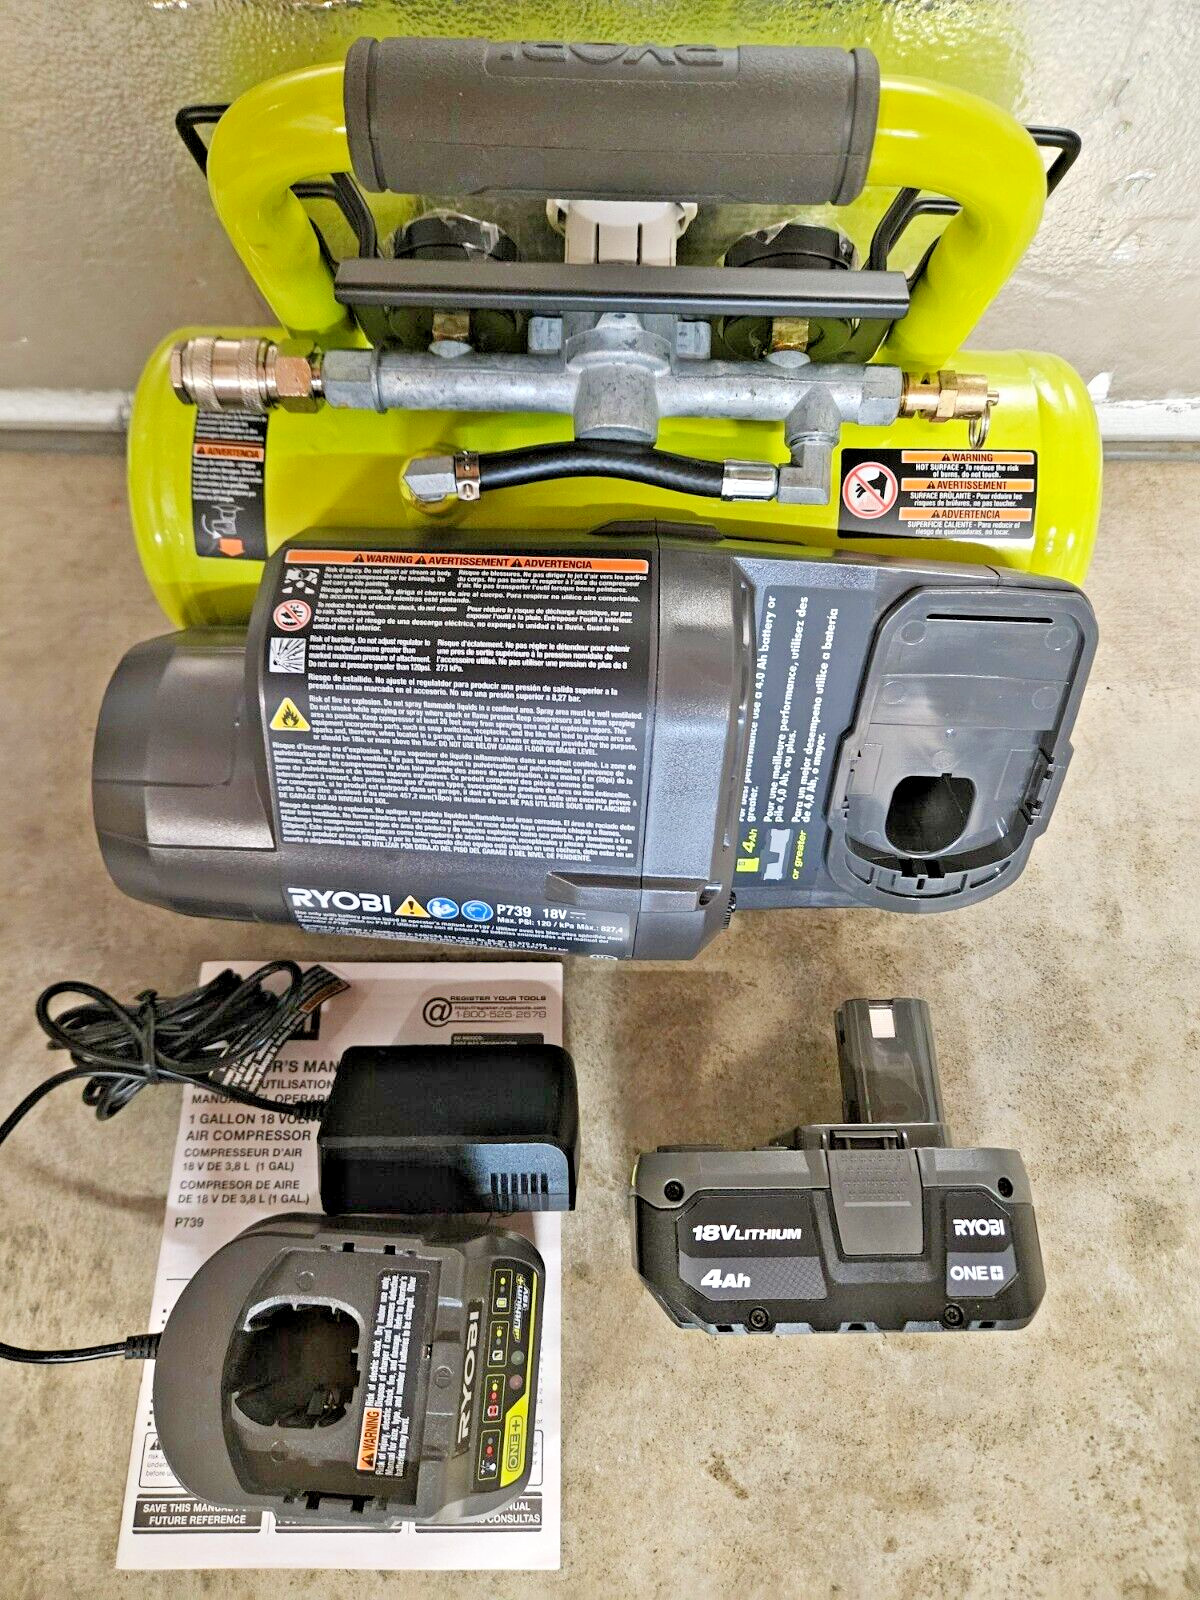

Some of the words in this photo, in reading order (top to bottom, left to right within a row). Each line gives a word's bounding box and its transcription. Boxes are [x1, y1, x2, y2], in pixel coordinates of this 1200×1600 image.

[952, 454, 993, 462] WARNING
[937, 481, 1007, 489] AVERTISSEMENT
[942, 510, 1000, 518] ADVERTENCIA
[365, 554, 414, 564] WARNING
[428, 556, 510, 568] AVERTISSEMENT
[524, 558, 593, 569] ADVERTENCIA
[768, 595, 776, 608] or
[796, 596, 808, 618] des
[758, 611, 776, 652] battery
[821, 608, 838, 650] batería
[790, 620, 805, 660] utilisez
[757, 654, 768, 670] Ah
[822, 652, 830, 660] a
[436, 664, 448, 672] 273
[815, 662, 829, 694] utilice
[755, 691, 762, 699] a
[780, 661, 799, 732] performance,
[753, 701, 761, 719] use
[785, 729, 797, 753] plus.
[813, 732, 826, 765] mayor.
[772, 733, 786, 779] meilleure
[784, 756, 792, 768] ou
[779, 770, 792, 787] Ah,
[800, 756, 812, 785] mejor
[769, 781, 778, 799] une
[798, 786, 806, 799] un
[806, 776, 819, 793] Ah,
[747, 785, 759, 822] greater.
[776, 788, 787, 804] 4,0
[804, 794, 815, 809] 4,0
[763, 801, 774, 822] Pour
[775, 804, 784, 822] pile
[791, 801, 803, 822] Para
[802, 810, 811, 823] de
[742, 828, 758, 854] 4Ah
[794, 829, 807, 867] greater
[792, 868, 800, 880] or
[288, 888, 392, 913] RYOBI
[496, 904, 532, 917] P739
[543, 909, 567, 920] 18V
[497, 916, 516, 924] Max.
[519, 918, 535, 926] PSI:
[601, 926, 624, 934] 827,4
[190, 1115, 194, 1124] 1
[200, 1114, 255, 1124] GALLON
[261, 1114, 274, 1124] 18
[186, 1130, 208, 1140] AIR
[213, 1130, 311, 1141] COMPRESSOR
[184, 1148, 269, 1157] COMPRESSEUR
[273, 1148, 302, 1157] D'AIR
[183, 1162, 193, 1171] 18
[197, 1162, 204, 1171] V
[207, 1162, 222, 1171] DE
[225, 1162, 241, 1171] 3,8
[244, 1162, 250, 1171] L
[256, 1162, 265, 1172] (1
[268, 1162, 294, 1172] GAL)
[180, 1180, 252, 1189] COMPRESOR
[256, 1180, 271, 1189] DE
[273, 1180, 300, 1189] AIRE
[178, 1195, 193, 1203] DE
[197, 1195, 208, 1203] 18
[211, 1195, 219, 1203] V
[222, 1195, 237, 1203] DE
[240, 1195, 256, 1205] 3,8
[259, 1195, 266, 1203] L
[268, 1194, 277, 1205] (1
[281, 1194, 309, 1205] GAL.)
[175, 1217, 204, 1227] P739
[952, 1218, 1005, 1236] RYOBI
[700, 1268, 751, 1289] 4Ah
[458, 1311, 479, 1443] RYOBI
[363, 1411, 380, 1451] WARNING
[143, 1504, 166, 1513] SAVE
[170, 1504, 190, 1512] THIS
[149, 1516, 187, 1525] FUTURE
[190, 1515, 246, 1524] REFERENCE
[487, 1514, 540, 1523] CONSULTAS
